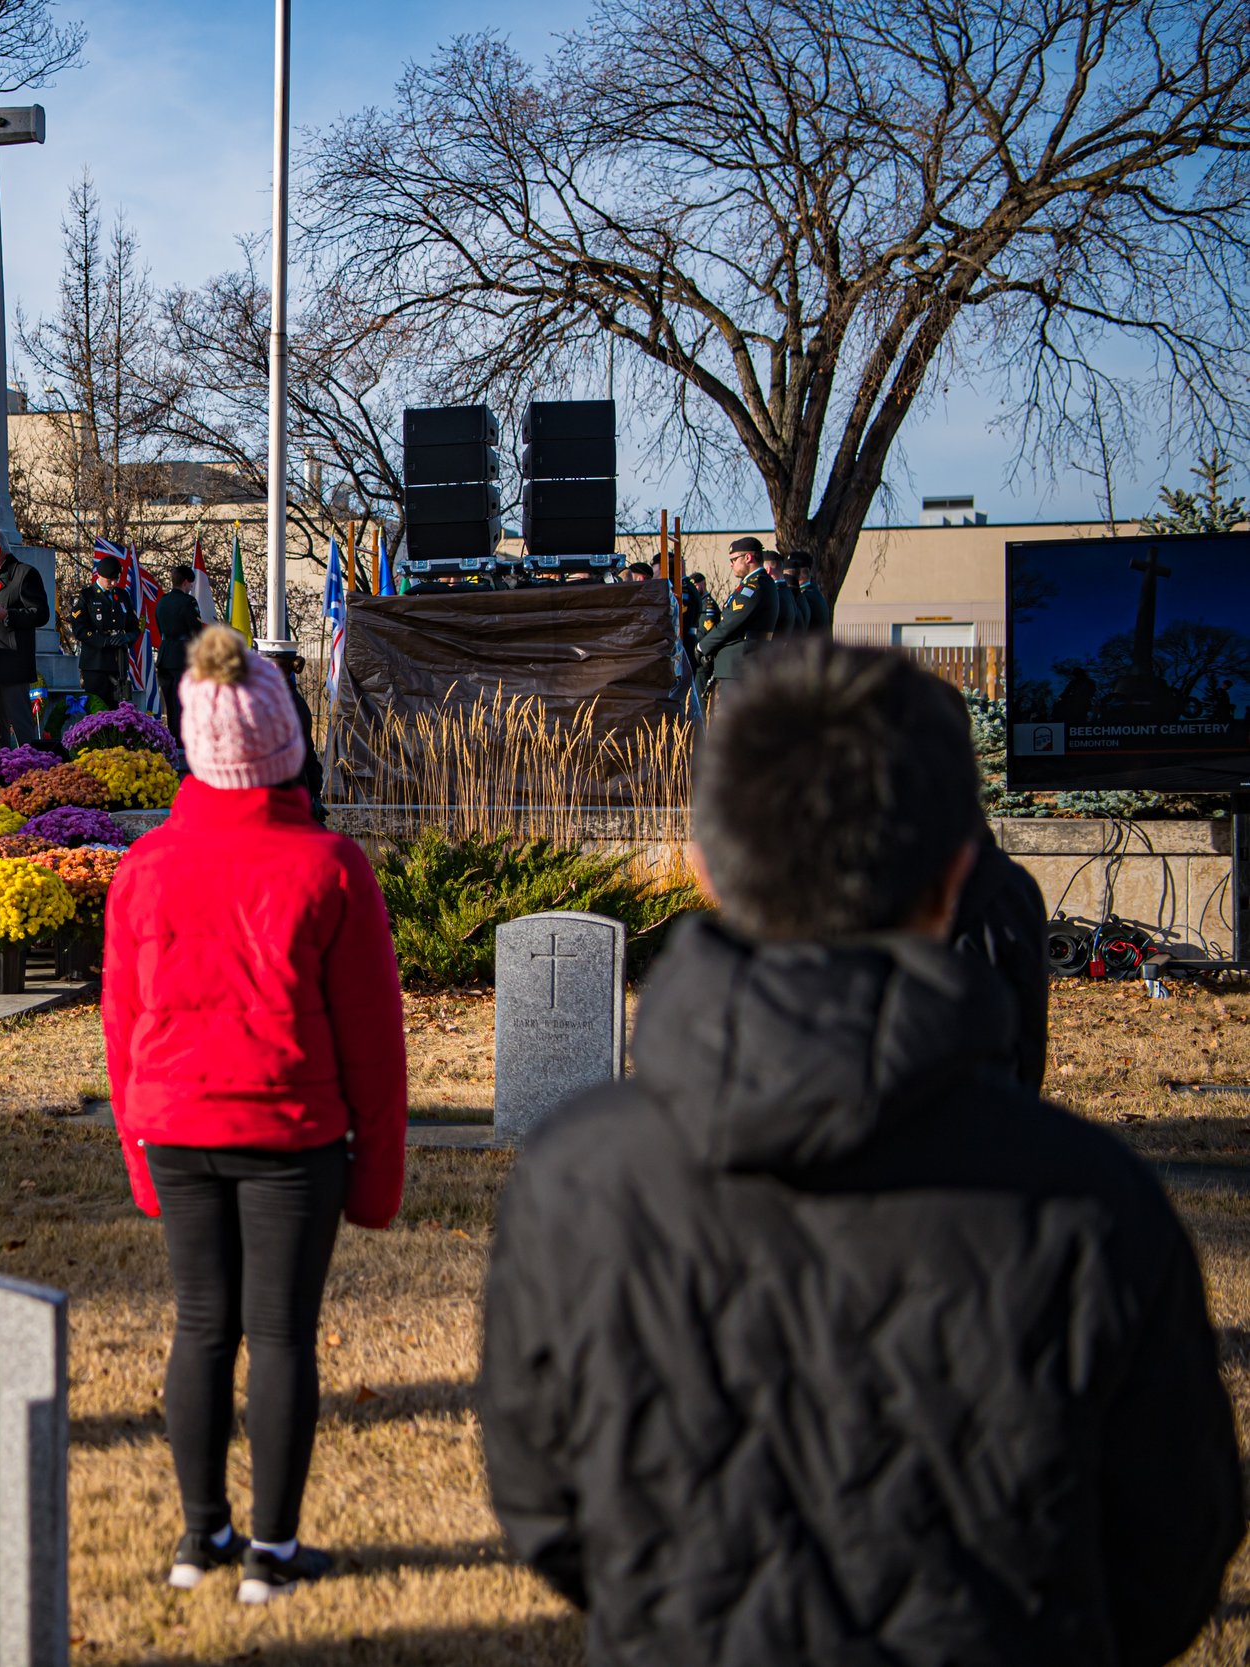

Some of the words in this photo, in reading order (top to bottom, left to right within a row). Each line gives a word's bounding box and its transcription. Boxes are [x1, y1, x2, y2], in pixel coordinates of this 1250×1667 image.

[1069, 724, 1158, 737] BEECHMOUNT
[1160, 722, 1230, 735] CEMETERY
[1069, 738, 1119, 748] EDMONTON
